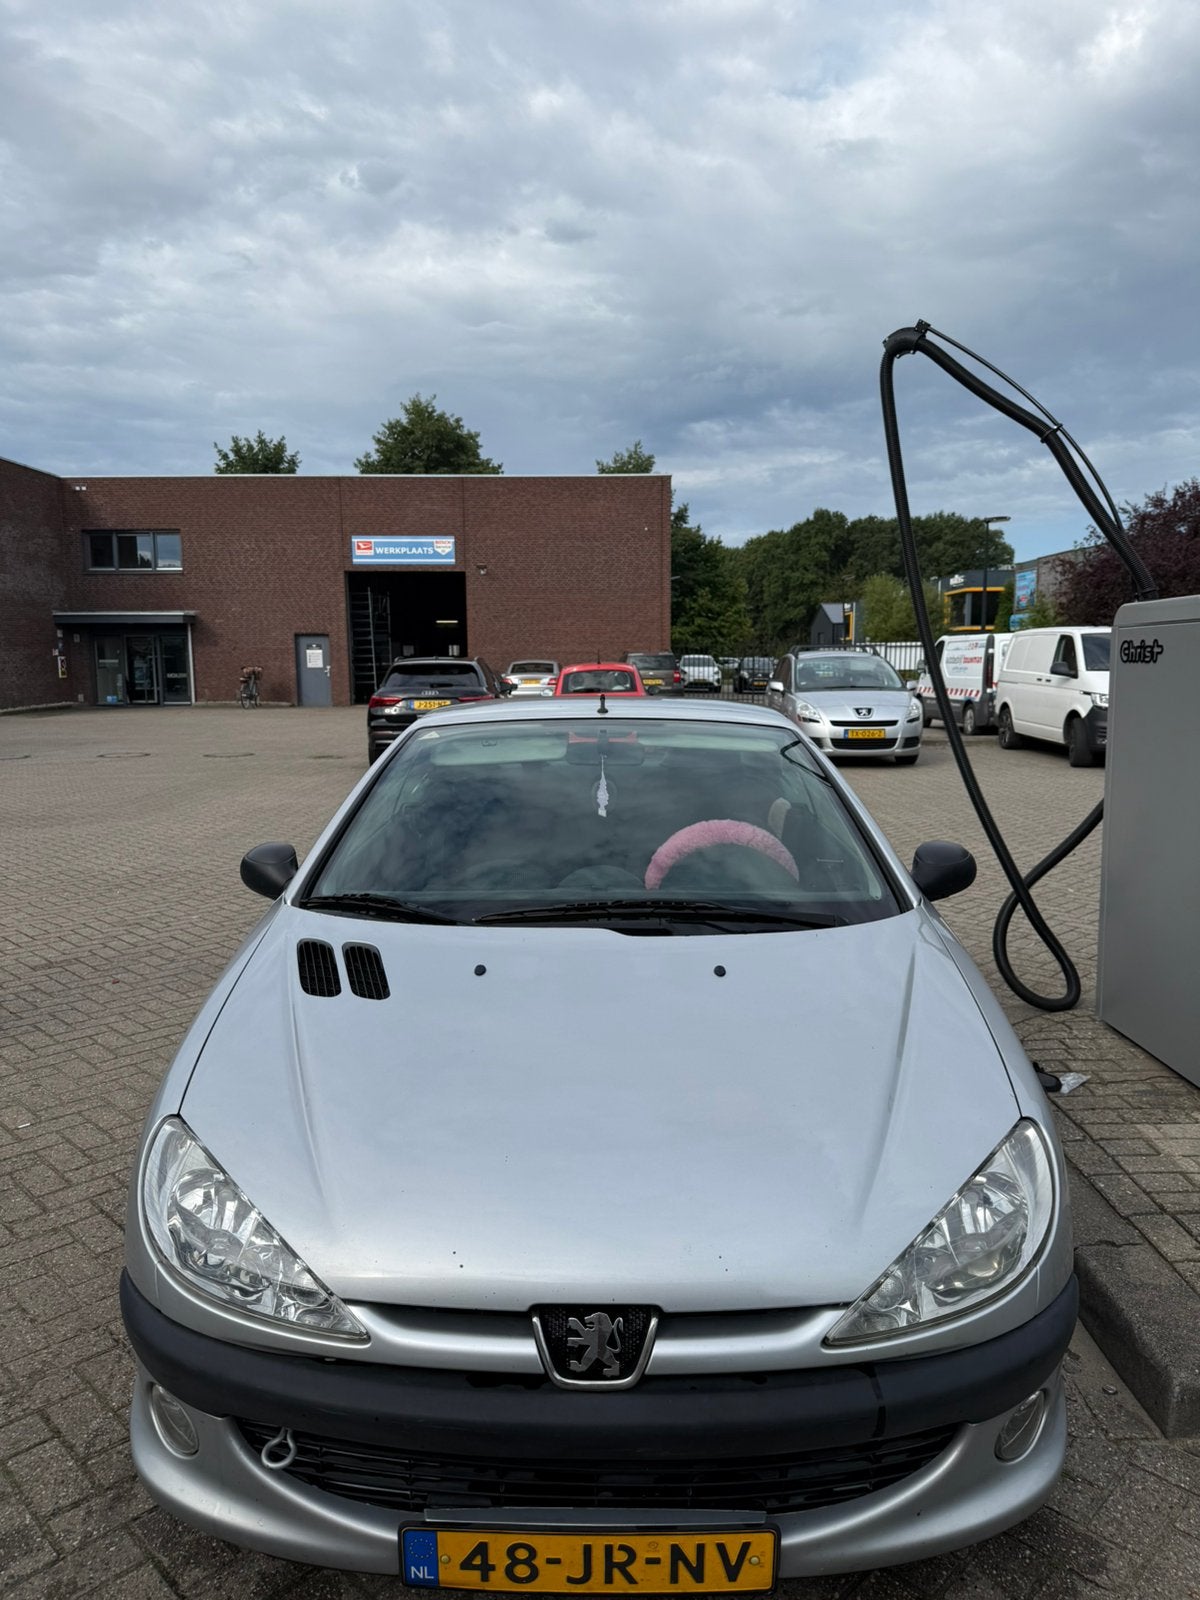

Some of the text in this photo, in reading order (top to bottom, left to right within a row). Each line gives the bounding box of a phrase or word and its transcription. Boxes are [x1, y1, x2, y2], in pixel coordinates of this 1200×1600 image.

[375, 547, 434, 555] WERKPLAATS
[1120, 638, 1164, 664] Christ
[410, 1566, 434, 1579] NL
[459, 1541, 752, 1585] 48-JR-NV
